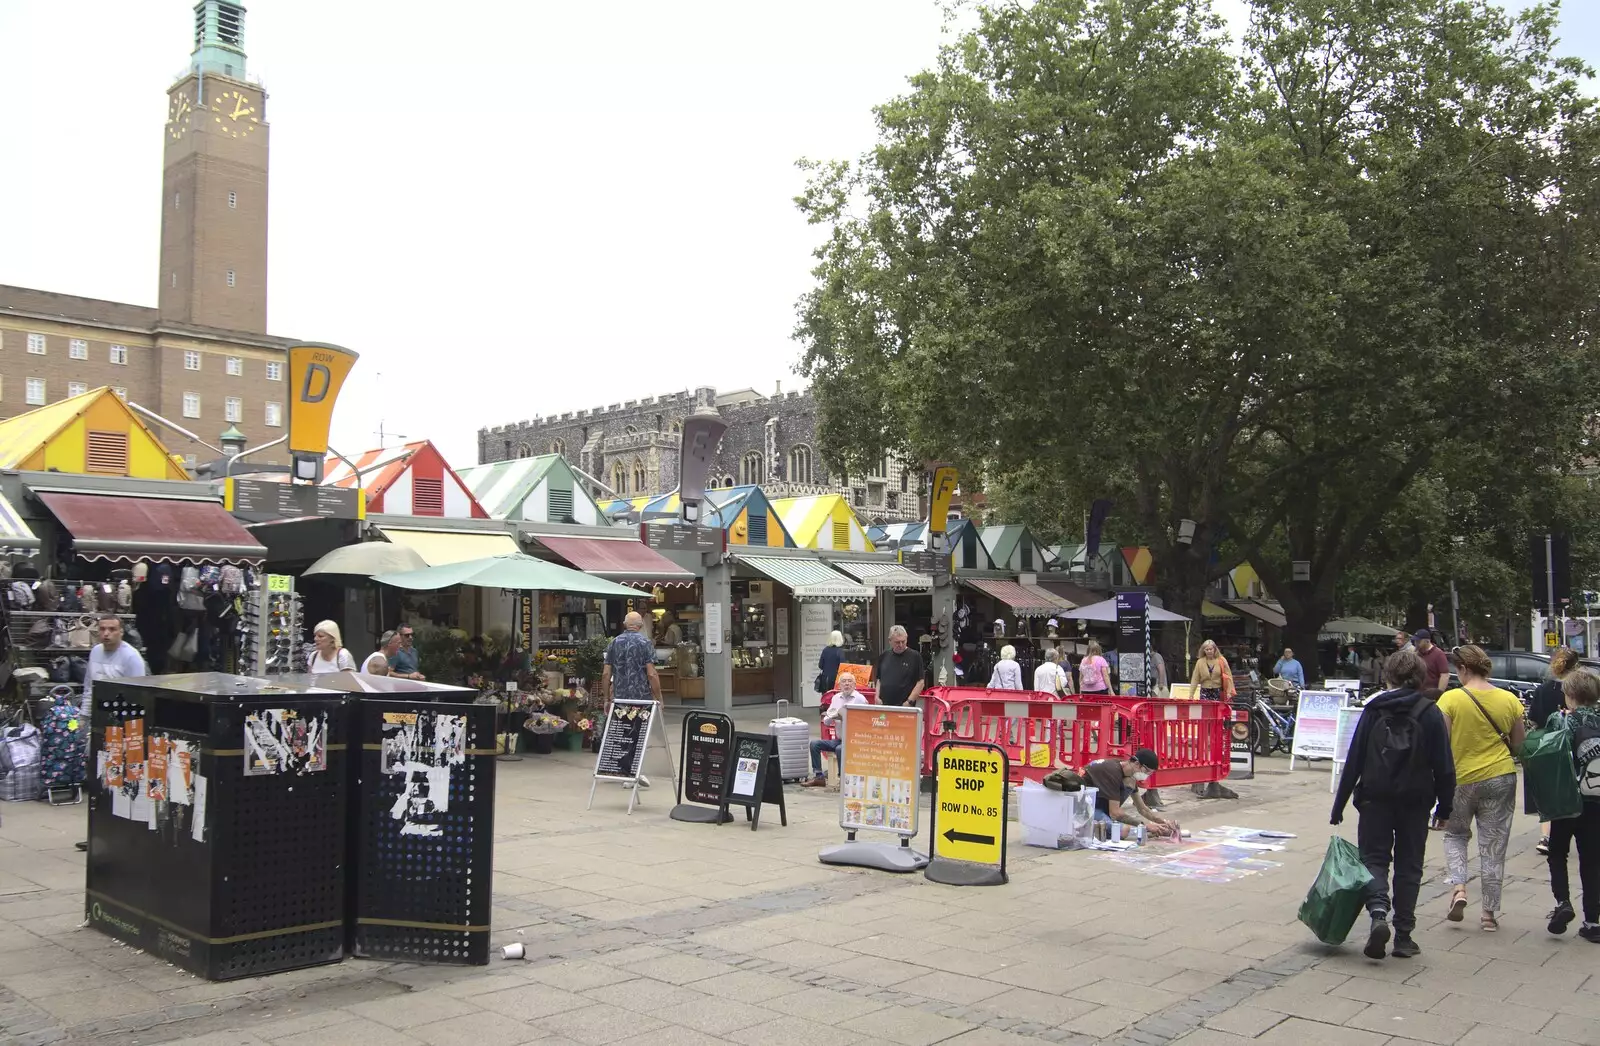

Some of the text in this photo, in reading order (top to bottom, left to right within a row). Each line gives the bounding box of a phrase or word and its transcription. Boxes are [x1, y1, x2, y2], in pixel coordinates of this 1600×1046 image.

[312, 352, 334, 362] ROW
[300, 362, 331, 403] D
[937, 476, 952, 500] F
[522, 597, 531, 649] CREPES
[551, 648, 578, 656] CREPES
[1315, 695, 1332, 703] POP
[1303, 703, 1341, 712] FASHION
[943, 757, 998, 774] BARBER'S
[955, 777, 985, 792] SHOP
[941, 801, 998, 817] ROW D No. 85
